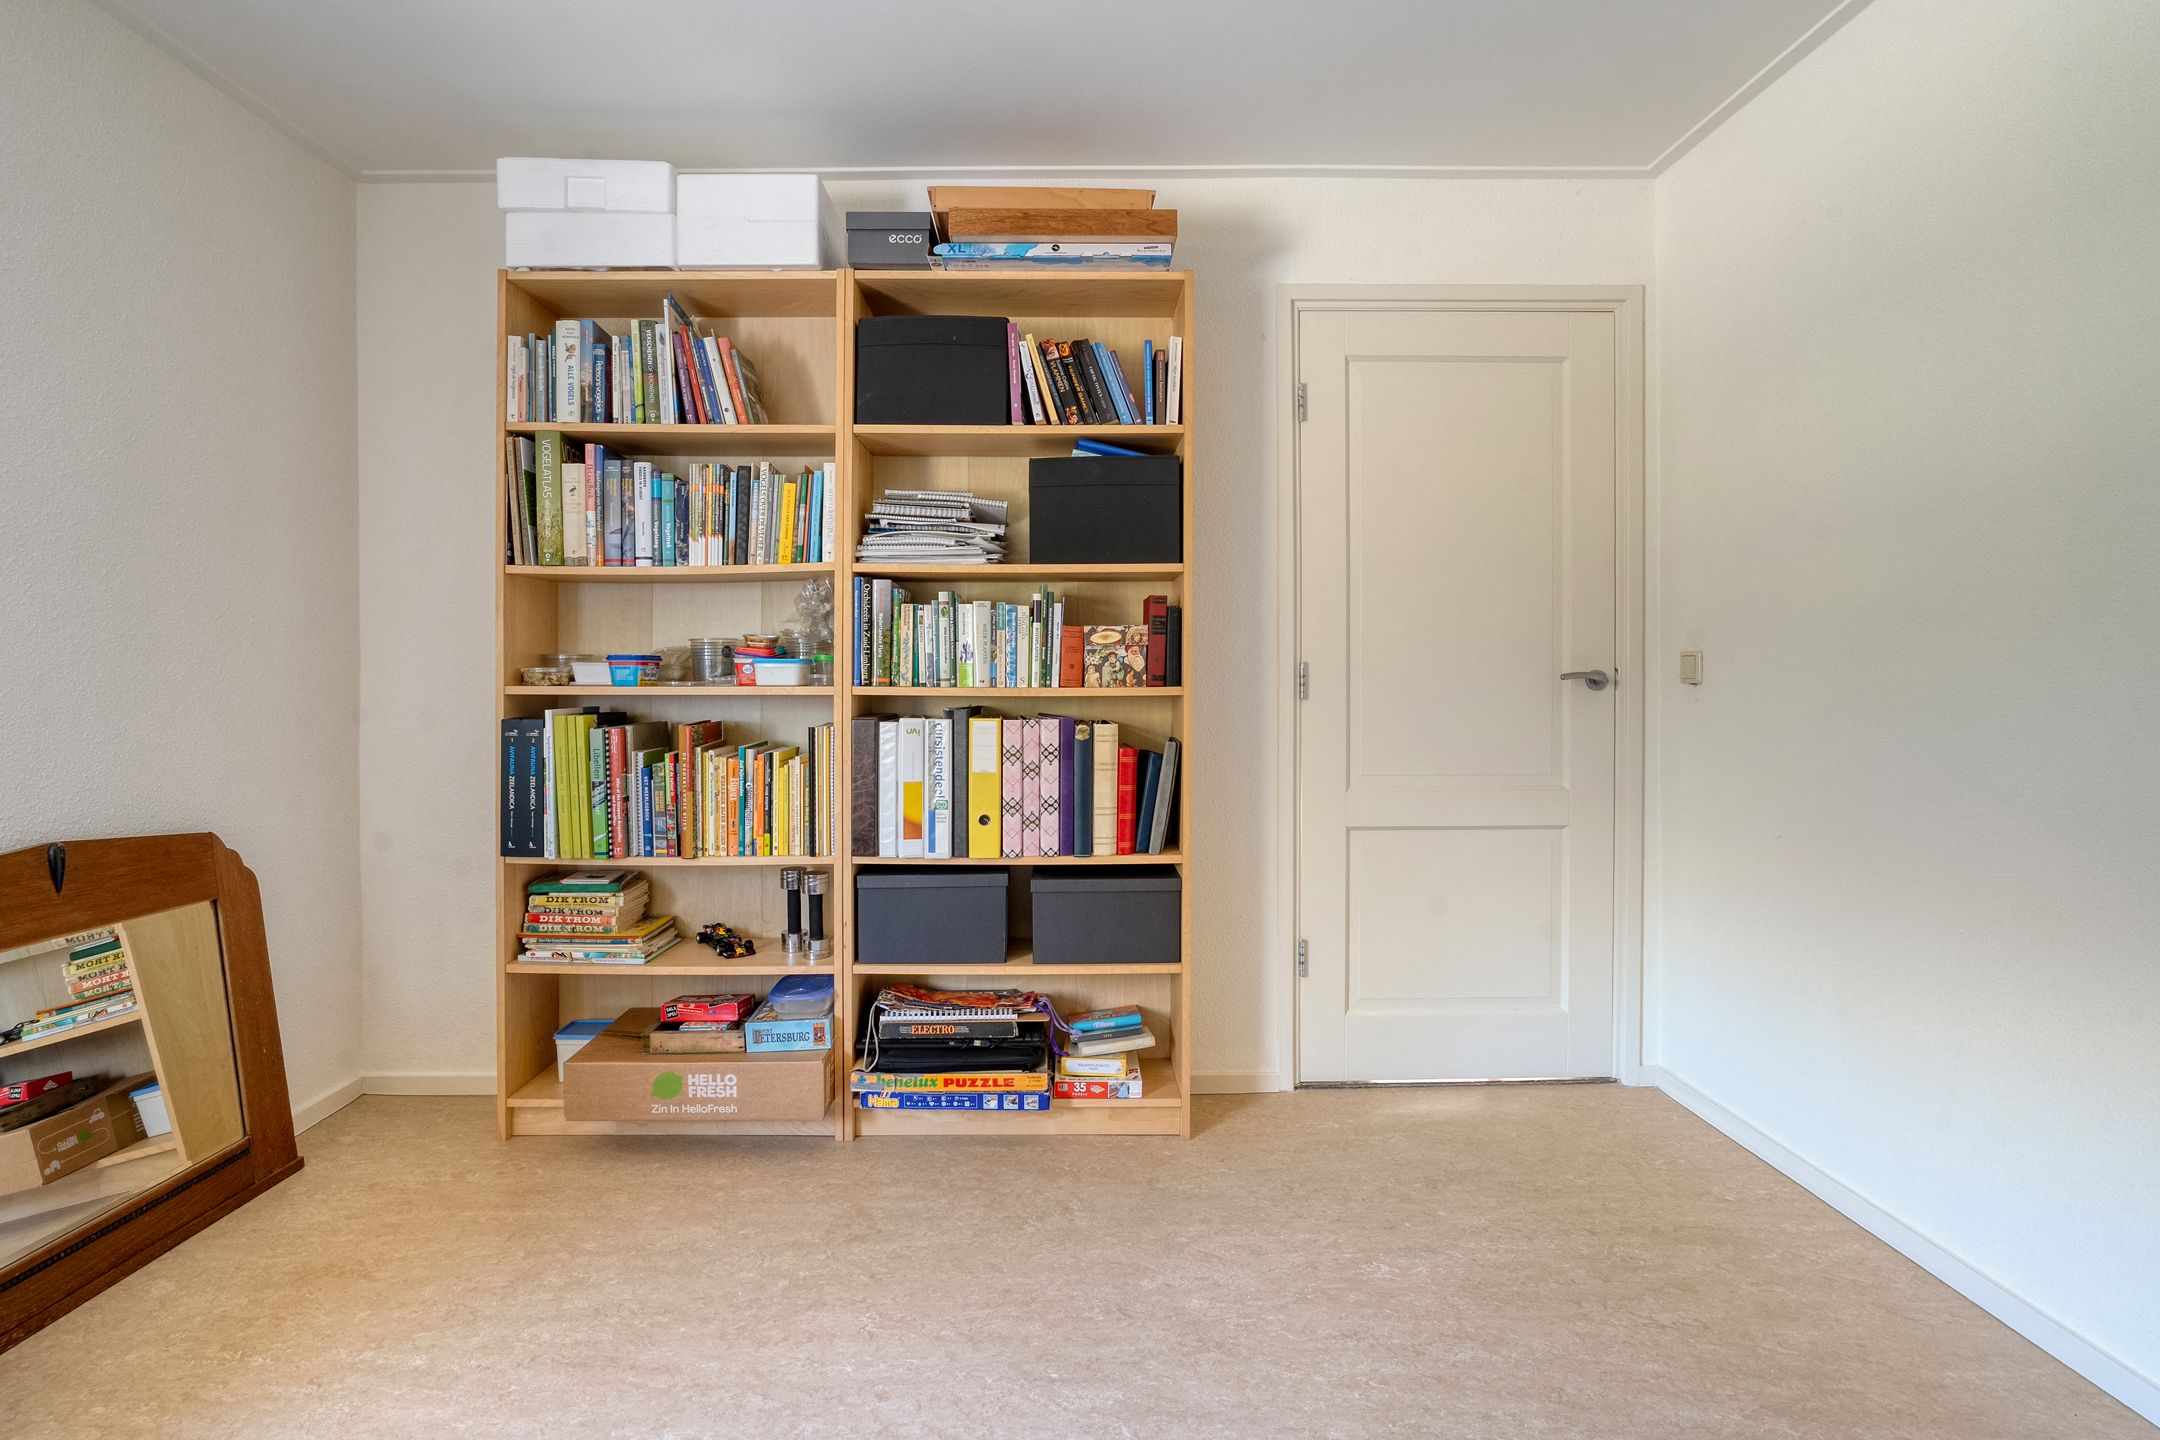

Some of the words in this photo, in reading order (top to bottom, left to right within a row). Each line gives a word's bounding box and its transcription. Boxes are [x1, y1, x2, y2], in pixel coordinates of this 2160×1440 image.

[888, 234, 920, 244] ecco
[947, 244, 966, 253] XL
[567, 365, 575, 380] ALLE
[595, 360, 603, 387] Petersons
[1050, 361, 1067, 393] VLAMMEN
[1067, 365, 1082, 392] HUNGER
[567, 382, 575, 406] VOGELS
[594, 388, 603, 414] vogelgids
[542, 439, 552, 498] VOGELATLAS
[760, 469, 768, 496] VOGELS
[759, 517, 766, 528] DE
[652, 522, 660, 548] Vogelzang
[862, 583, 871, 622] Orchideeën
[862, 631, 871, 679] Zuid-Limburg
[508, 746, 516, 775] AVIFAUNA
[529, 746, 537, 775] AVIFAUNA
[592, 748, 603, 779] Libellen
[683, 752, 687, 760] DE
[508, 776, 517, 810] ZEELANDICA
[529, 776, 538, 810] ZEELANDICA
[729, 778, 739, 801] Bijen
[545, 896, 569, 904] DIK
[539, 915, 563, 923] DIK
[566, 916, 602, 924] TROM
[568, 908, 603, 916] TROM
[563, 925, 604, 933] TROM
[752, 1030, 810, 1045] PETERSBURG
[911, 1025, 955, 1035] ELECTRO
[688, 1074, 737, 1086] HELLO
[943, 1078, 1014, 1089] PUZZLE
[688, 1086, 737, 1098] FRESH
[1073, 1083, 1086, 1093] 35
[868, 1094, 899, 1108] Hama
[651, 1104, 668, 1114] Zin
[681, 1104, 738, 1114] HelloFresh
